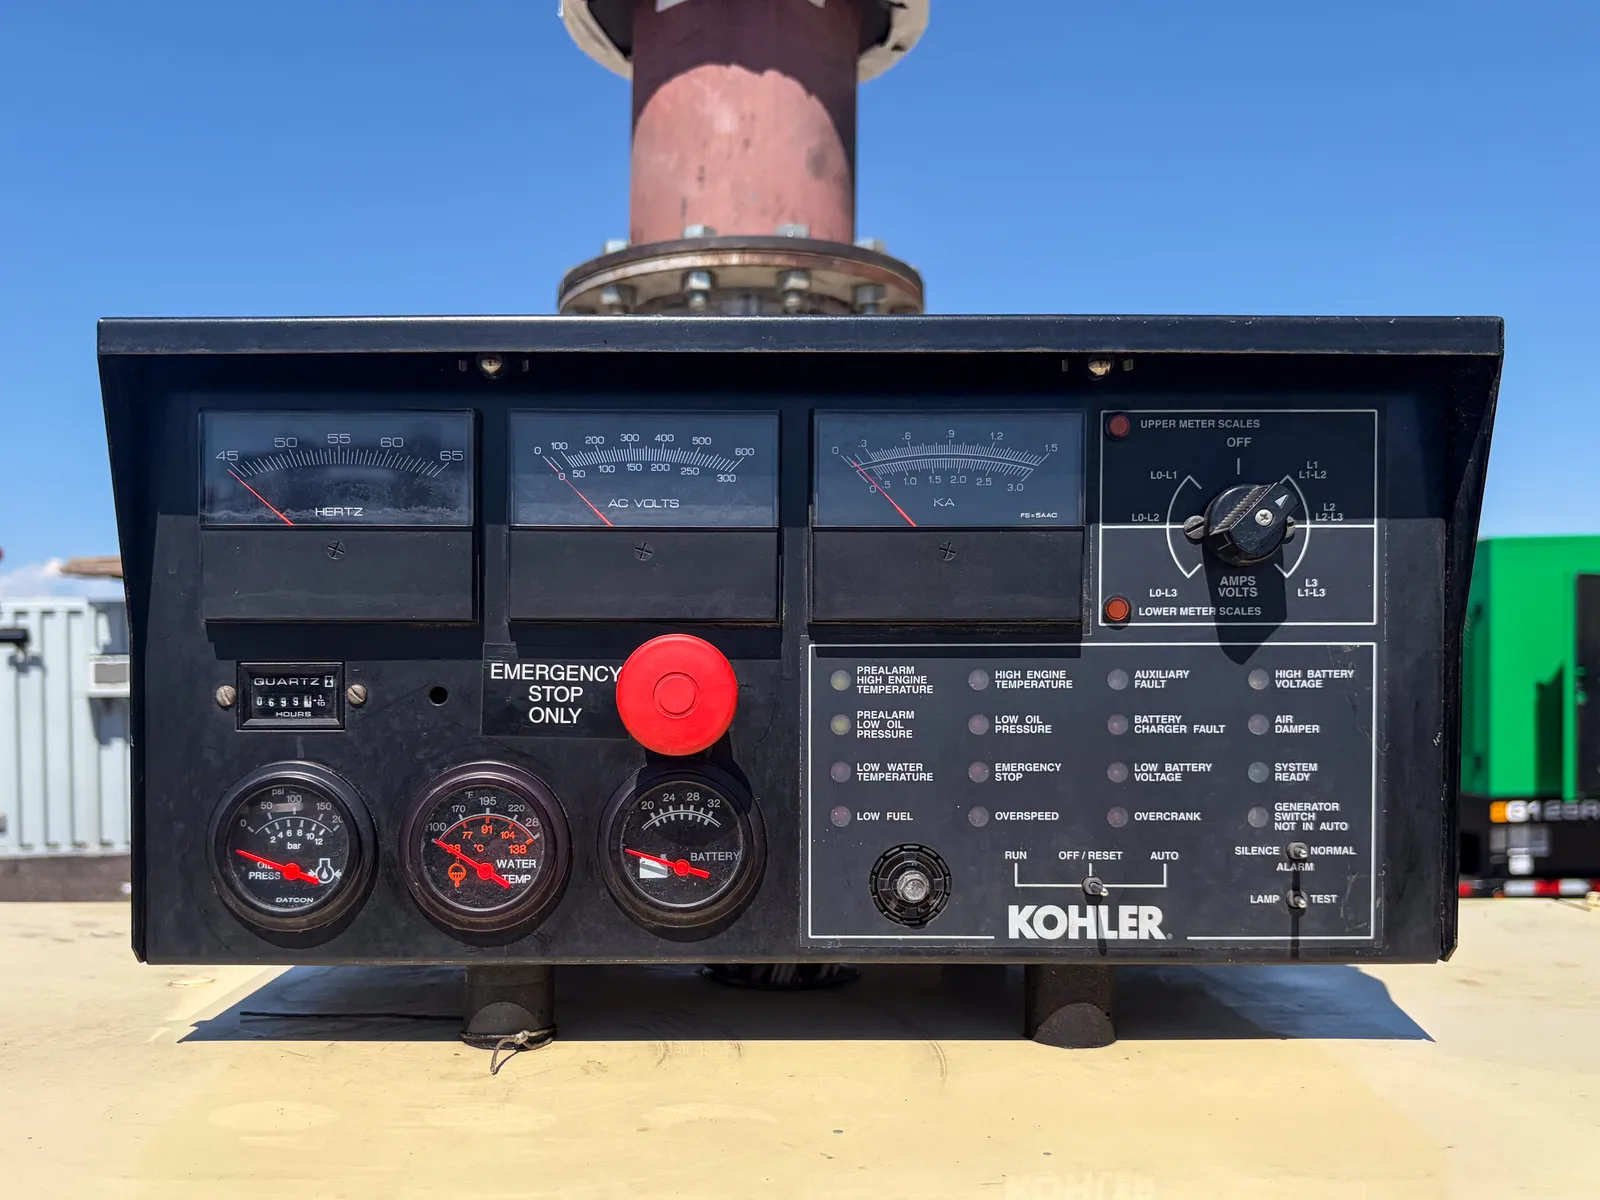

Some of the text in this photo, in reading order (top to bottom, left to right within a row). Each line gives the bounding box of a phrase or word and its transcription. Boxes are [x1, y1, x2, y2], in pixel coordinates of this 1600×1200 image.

[1141, 420, 1260, 428] UPPER METER SCALES
[534, 434, 754, 456] 0 100 200 300 400 500 600
[831, 430, 1058, 455] 0 .3 .6 .9 1.2 1.5
[1226, 437, 1252, 447] OFF
[215, 434, 463, 461] 45 50 55 60 65
[1307, 461, 1318, 469] L1
[558, 463, 736, 482] 0 50 100 150 200 250 300
[1299, 471, 1326, 479] L1-L2
[869, 475, 1023, 493] 0 .5 1.0 1.5 2.0 2.5 3.0
[608, 499, 679, 508] AC VOLTS
[1324, 503, 1335, 511] L2
[315, 508, 363, 517] HERTZ
[1316, 513, 1343, 521] L2-L3
[1220, 576, 1256, 586] AMPS
[1305, 579, 1318, 587] L3
[1218, 587, 1258, 597] VOLTS
[1298, 588, 1326, 597] L1-L3
[1139, 607, 1261, 616] LOWER METER SCALES
[491, 663, 622, 682] EMERGENCY
[857, 666, 915, 675] PREALARM
[995, 670, 1066, 679] HIGH ENGINE
[1134, 670, 1190, 679] AUXILIARY
[1275, 670, 1354, 678] HIGH BATTERY
[857, 676, 927, 685] HIGH ENGINE
[995, 680, 1073, 689] TEMPERATURE
[1134, 680, 1167, 689] FAULT
[1275, 680, 1323, 688] VOLTAGE
[529, 685, 583, 702] STOP
[857, 685, 933, 694] TEMPERATURE
[529, 707, 582, 724] ONLY
[857, 711, 915, 719] PREALARM
[995, 715, 1043, 724] LOW OIL
[1134, 715, 1182, 724] BATTERY
[1275, 715, 1293, 723] AIR
[857, 720, 904, 729] LOW OIL
[857, 730, 913, 738] PRESSURE
[995, 725, 1052, 734] PRESSURE
[1134, 725, 1226, 734] CHARGER FAULT
[1275, 725, 1320, 734] DAMPER
[857, 763, 923, 772] LOW WATER
[995, 763, 1062, 772] EMERGENCY
[1134, 763, 1212, 772] LOW BATTERY
[1275, 763, 1318, 772] SYSTEM
[857, 773, 933, 781] TEMPERATURE
[995, 773, 1022, 781] STOP
[1134, 773, 1182, 782] VOLTAGE
[1275, 773, 1310, 781] READY
[272, 788, 284, 796] psi
[641, 801, 654, 809] 20
[663, 793, 675, 801] 24
[687, 792, 700, 801] 28
[241, 819, 246, 827] 0
[286, 795, 302, 803] 100
[316, 802, 331, 810] 150
[332, 815, 343, 823] 20
[1274, 803, 1340, 811] GENERATOR
[429, 823, 446, 831] 100
[480, 797, 496, 805] 195
[526, 818, 539, 826] 28
[857, 812, 913, 820] LOW FUEL
[995, 812, 1059, 820] OVERSPEED
[1134, 812, 1201, 821] OVERCRANK
[1274, 812, 1316, 821] SWITCH
[1274, 822, 1349, 831] NOT IN AUTO
[481, 825, 492, 834] 91
[501, 831, 515, 839] 104
[509, 845, 526, 854] 138
[1005, 851, 1027, 860] RUN
[1150, 851, 1178, 860] AUTO
[1235, 847, 1280, 855] SILENCE
[1310, 847, 1357, 855] NORMAL
[691, 852, 740, 861] BATTERY
[497, 860, 536, 868] WATER
[1276, 863, 1314, 871] ALARM
[502, 875, 531, 883] TEMP
[1250, 895, 1280, 903] LAMP
[1311, 895, 1337, 903] TEST
[1008, 905, 1167, 939] KOHLER
